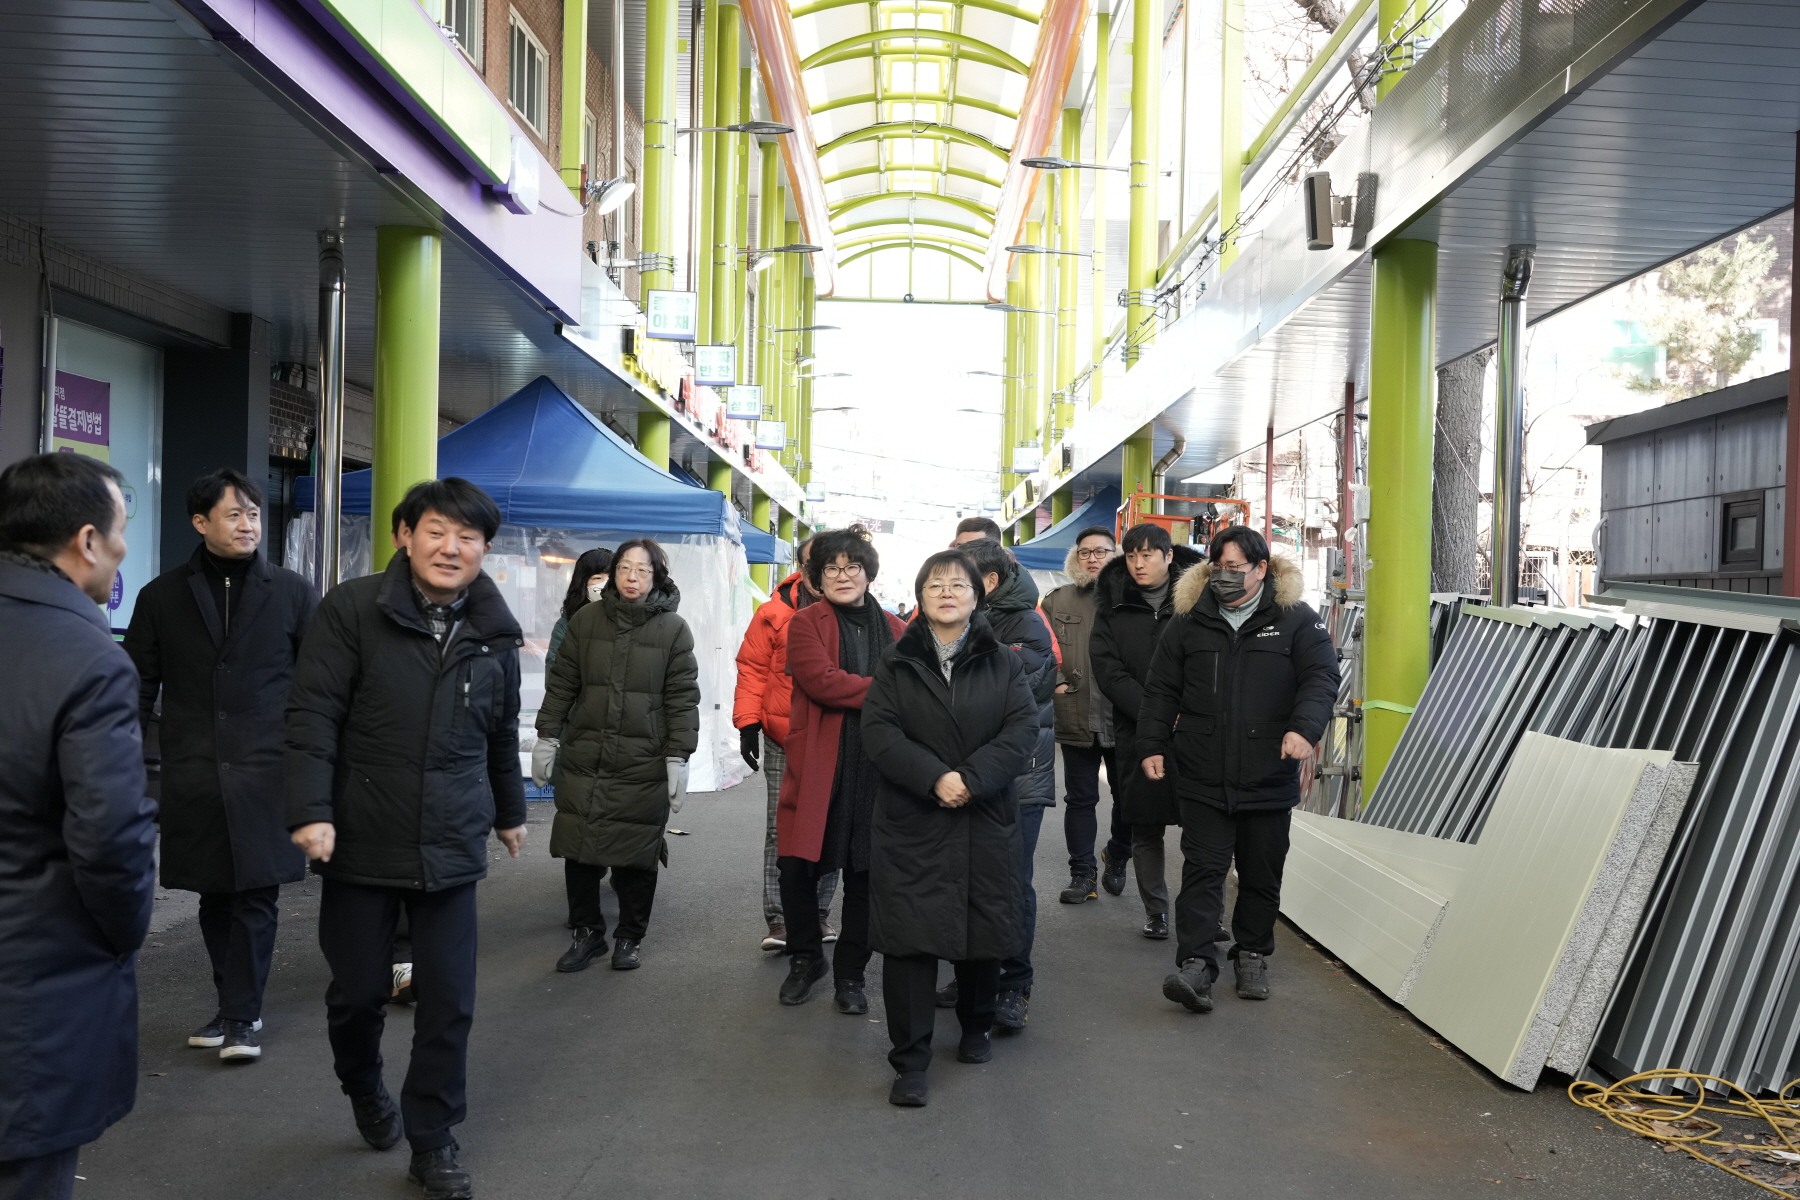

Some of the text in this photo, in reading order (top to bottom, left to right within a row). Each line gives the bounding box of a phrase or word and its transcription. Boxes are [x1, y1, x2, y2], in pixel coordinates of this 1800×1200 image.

[652, 313, 689, 330] 야채
[699, 365, 731, 378] 반찬
[55, 385, 65, 400] 의점
[730, 401, 757, 412] 상회
